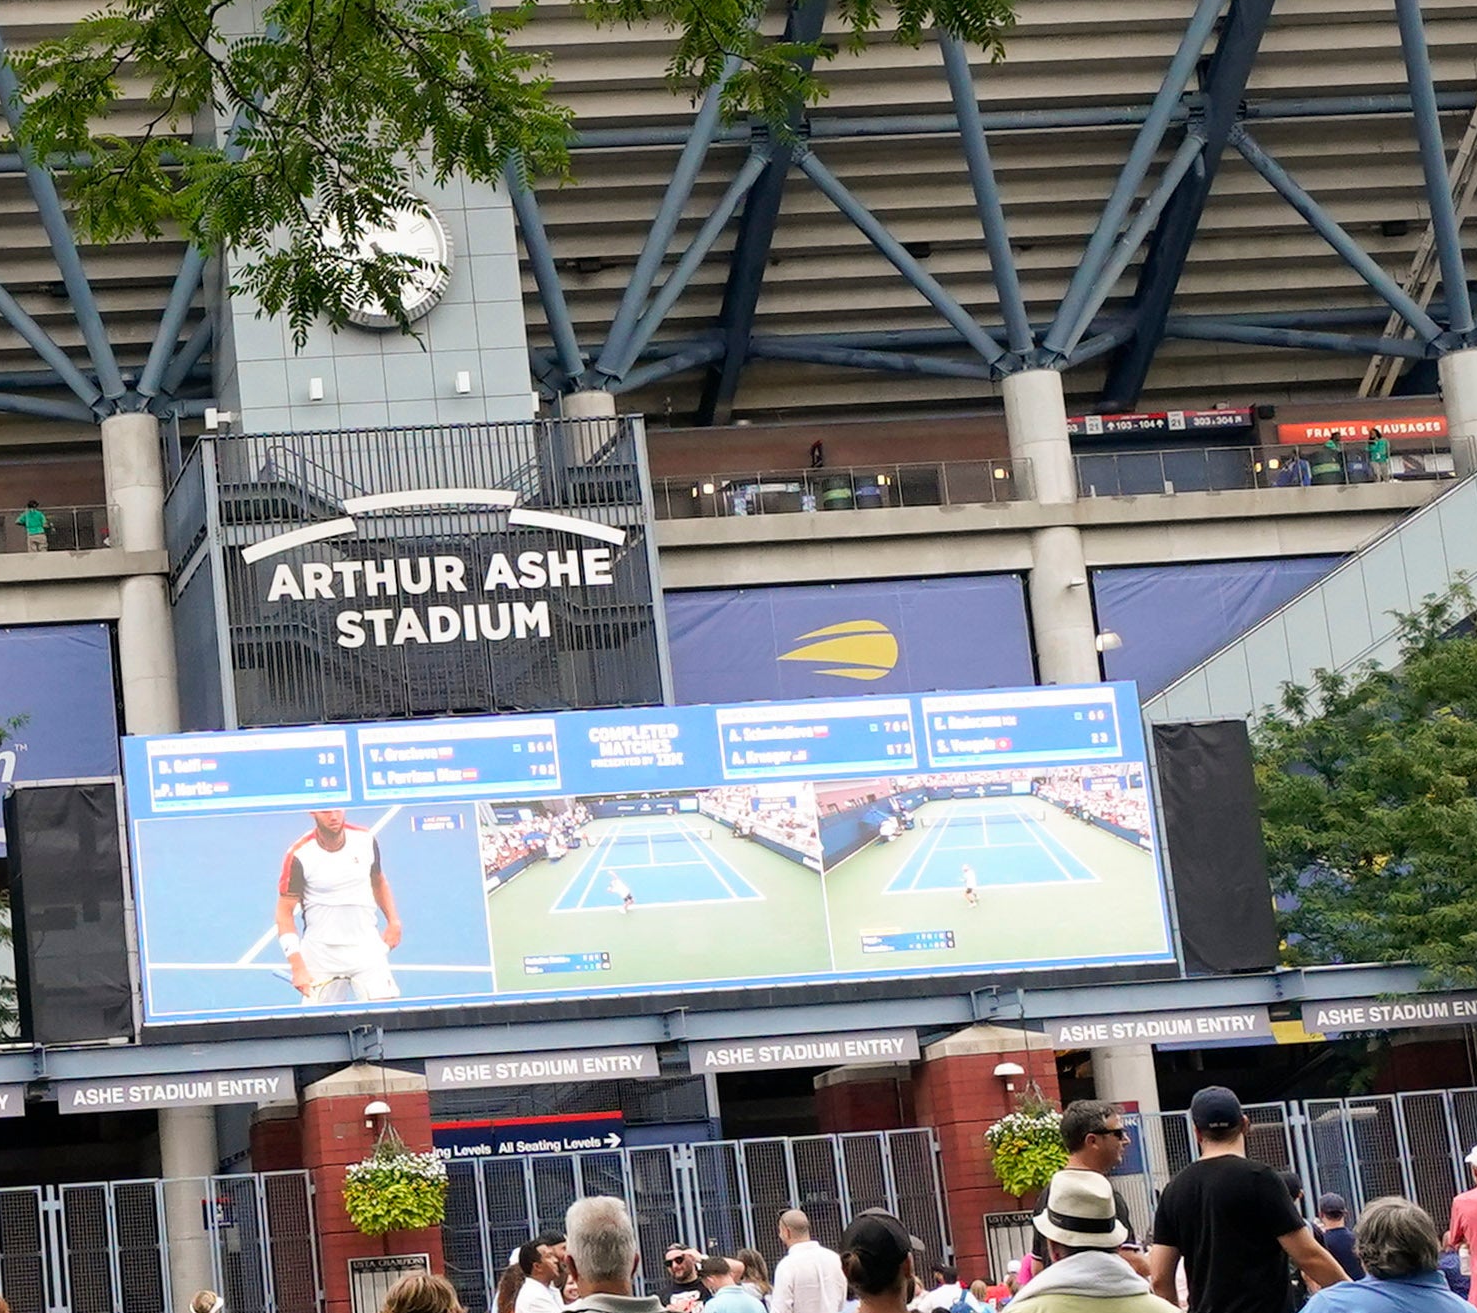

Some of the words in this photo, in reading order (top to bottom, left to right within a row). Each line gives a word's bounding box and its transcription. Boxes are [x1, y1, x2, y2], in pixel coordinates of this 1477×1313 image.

[1116, 421, 1132, 429] 103
[1139, 420, 1156, 429] 104
[267, 554, 467, 602] ARTHUR
[485, 545, 613, 589] ASHE
[336, 600, 551, 649] STADIUM
[589, 725, 679, 741] COMPLETED
[1315, 1007, 1365, 1026] ASHE
[1369, 1001, 1448, 1023] STADIUM
[1058, 1024, 1110, 1043] ASHE
[1112, 1019, 1193, 1040] STADIUM
[1197, 1014, 1257, 1034] ENTRY
[704, 1047, 754, 1067] ASHE
[758, 1042, 842, 1063] STADIUM
[845, 1037, 905, 1057] ENTRY
[441, 1064, 493, 1083] ASHE
[495, 1059, 580, 1080] STADIUM
[585, 1054, 644, 1074] ENTRY
[72, 1085, 124, 1106] ASHE
[128, 1081, 213, 1103] STADIUM
[218, 1077, 280, 1097] ENTRY
[454, 1143, 492, 1156] Levels
[498, 1141, 514, 1154] All
[516, 1139, 562, 1153] Seating
[564, 1137, 602, 1150] Levels
